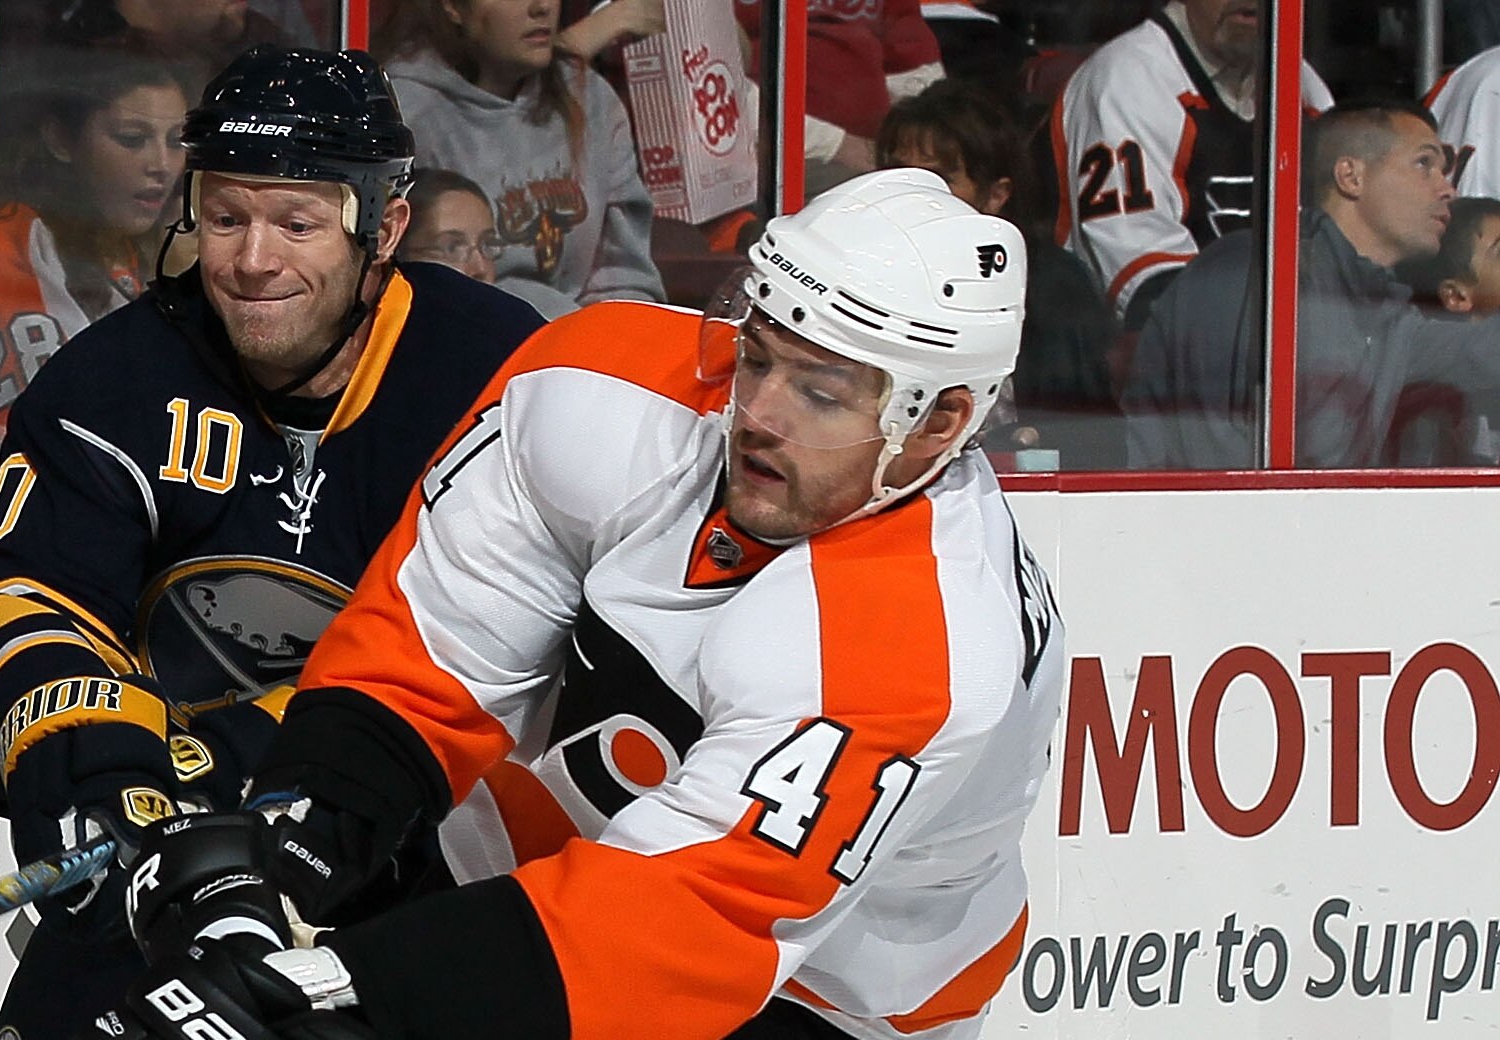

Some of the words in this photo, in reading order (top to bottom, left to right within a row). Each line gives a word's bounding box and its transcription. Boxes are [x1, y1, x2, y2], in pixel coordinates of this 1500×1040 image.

[1077, 139, 1156, 223] 21
[159, 396, 244, 495] 10
[161, 818, 193, 837] MEZ
[740, 716, 921, 887] 41
[1007, 929, 1201, 1013] ower
[1216, 911, 1289, 1003] to
